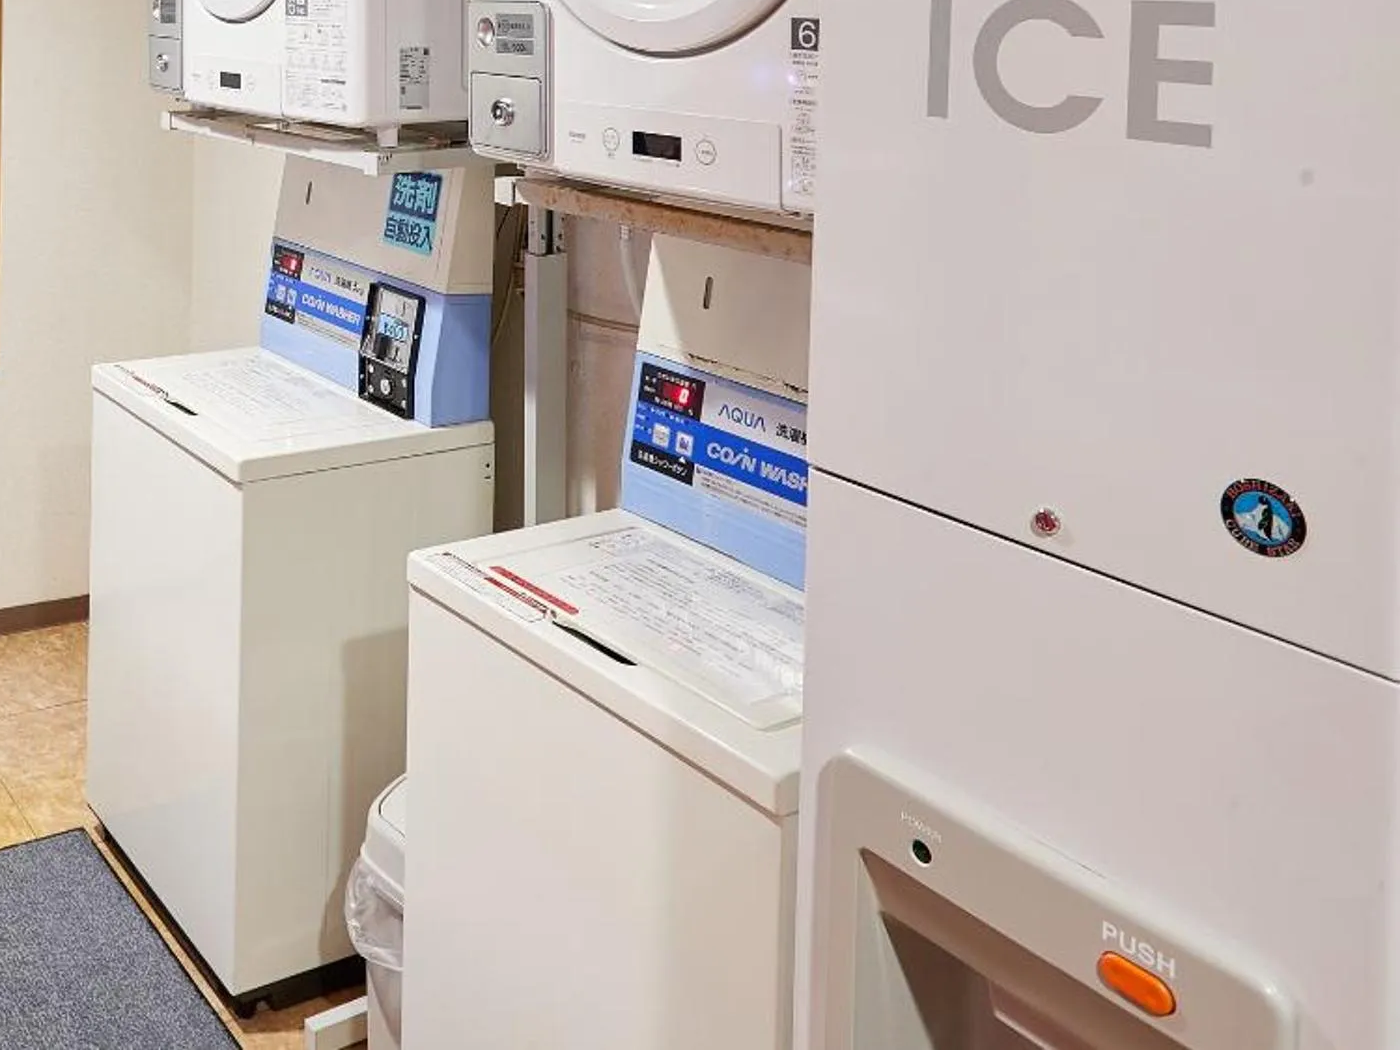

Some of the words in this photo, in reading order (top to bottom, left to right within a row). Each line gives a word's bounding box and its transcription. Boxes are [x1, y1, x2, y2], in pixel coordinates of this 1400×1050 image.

[798, 20, 817, 50] 6
[393, 172, 437, 215] 洗剤
[384, 215, 433, 250] 自動投入
[718, 404, 767, 433] AQUA
[706, 442, 757, 473] COIN
[1102, 920, 1177, 980] PUSH
